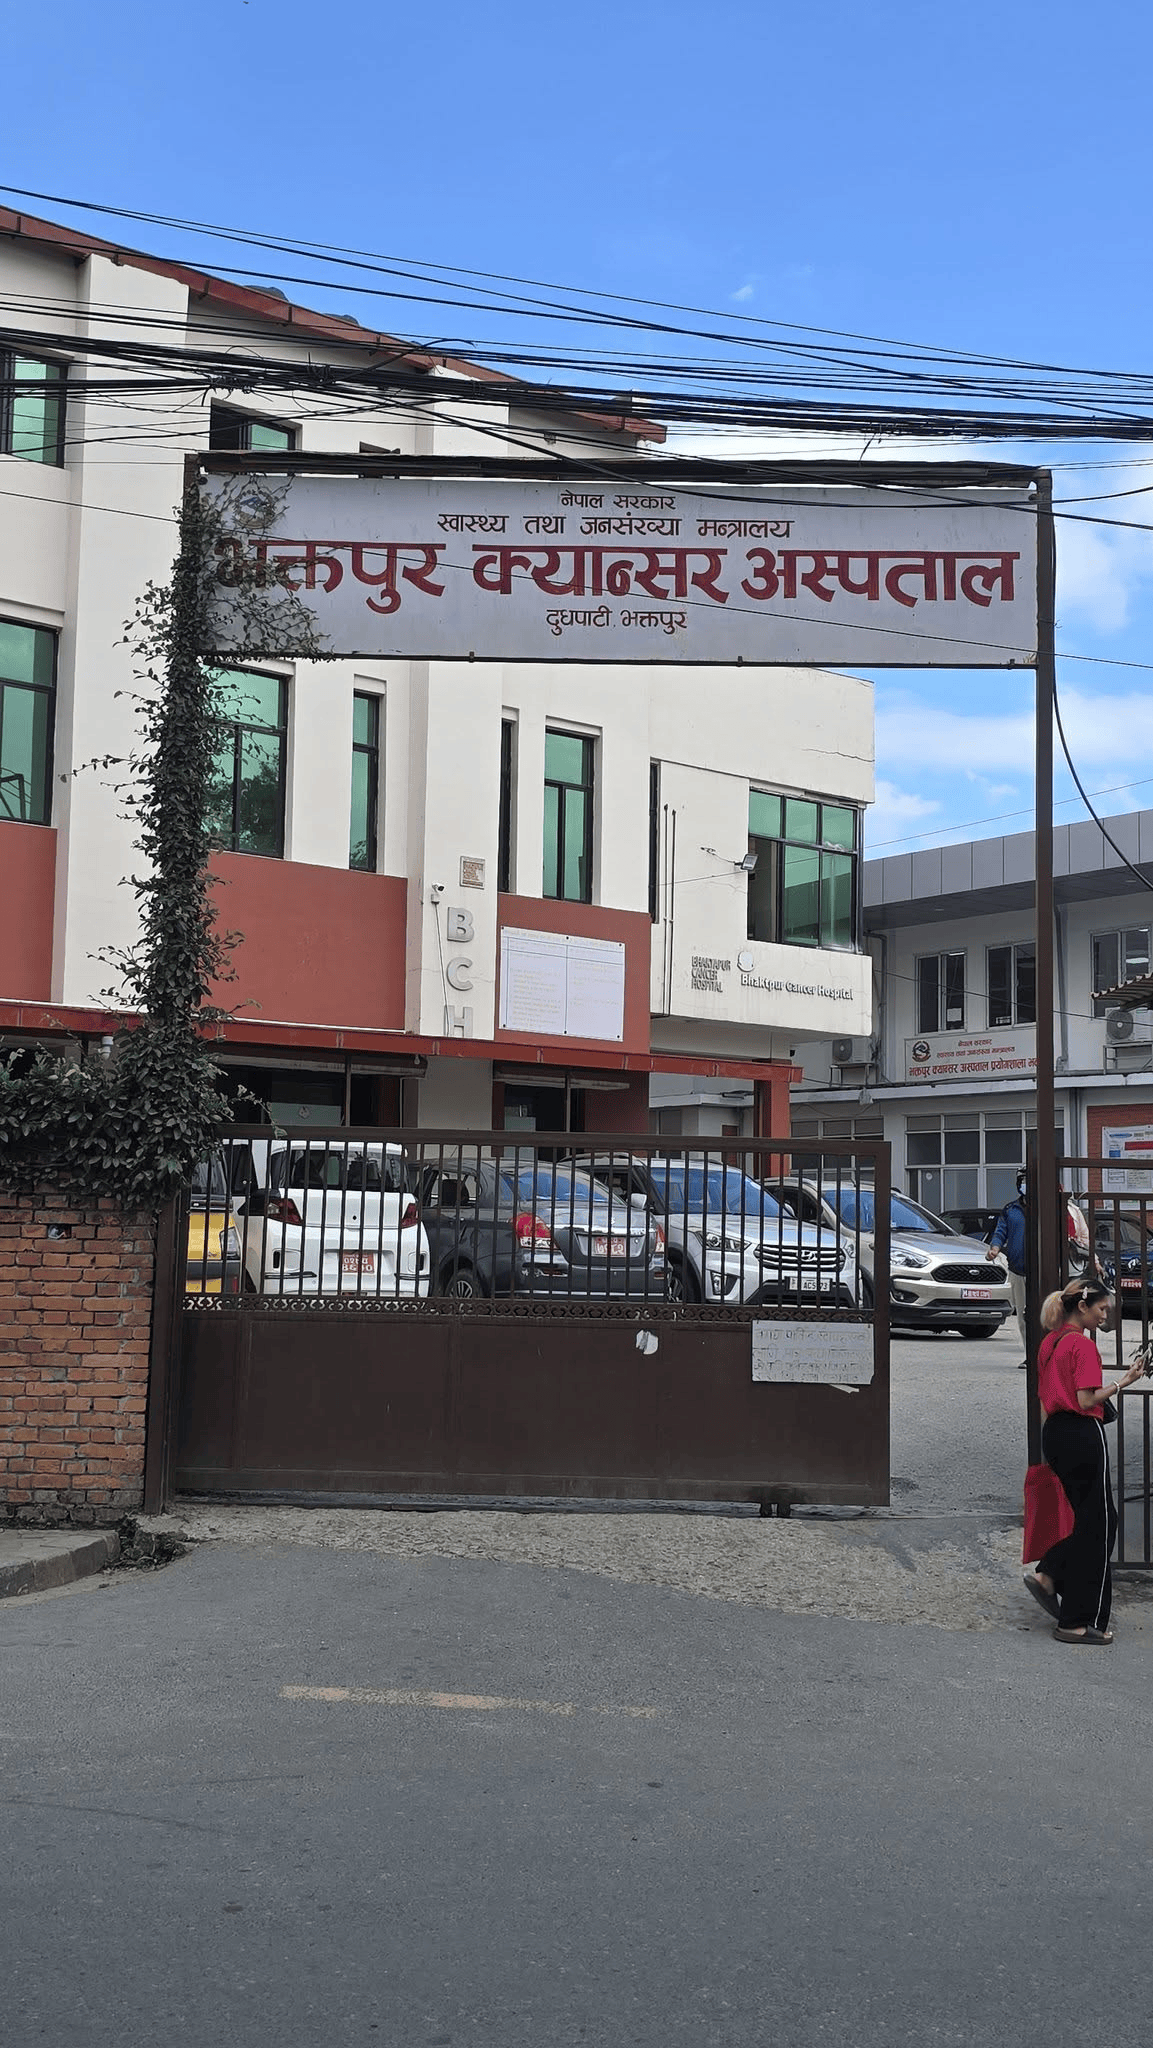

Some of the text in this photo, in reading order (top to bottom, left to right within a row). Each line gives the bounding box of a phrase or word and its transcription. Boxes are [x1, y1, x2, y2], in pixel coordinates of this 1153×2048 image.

[560, 489, 676, 510] नेपाल सरकार
[437, 511, 795, 539] स्वास्थ्य तथा जनसंख्या मन्त्रालय
[472, 543, 730, 604] क्यान्सर
[741, 546, 1020, 608] अस्पताल
[620, 608, 688, 635] भक्तपुर
[691, 967, 718, 981] CANCER
[691, 977, 723, 993] HOSPITAL
[785, 981, 816, 995] Cancer
[817, 984, 854, 1001] Hospital
